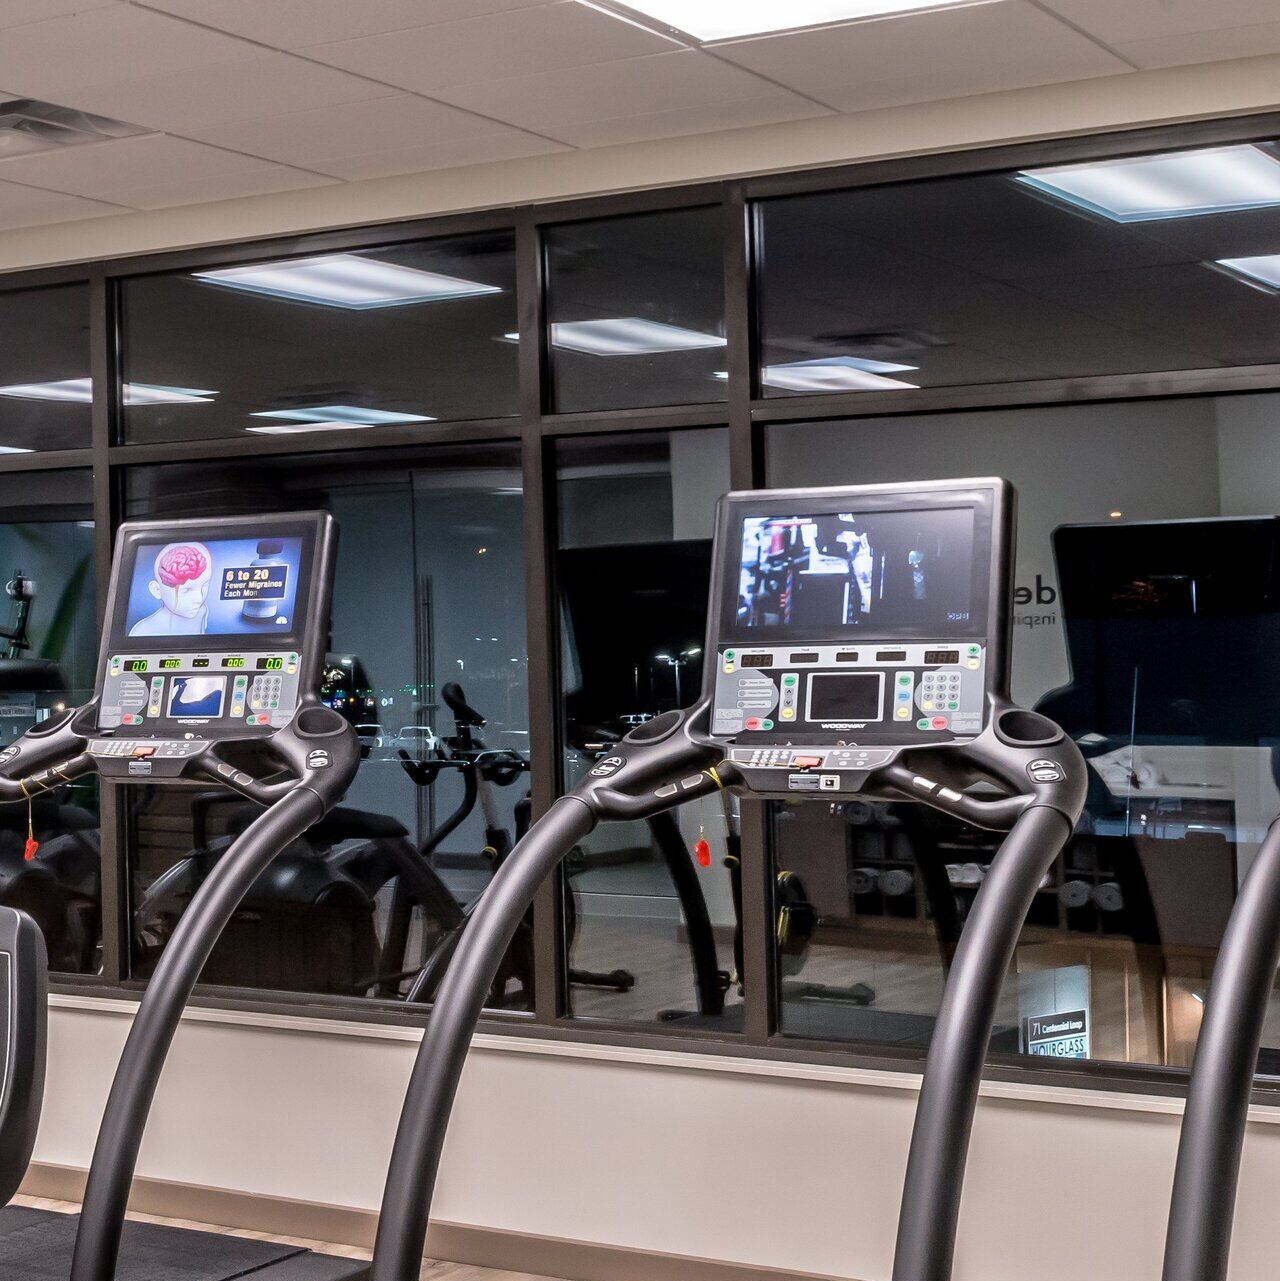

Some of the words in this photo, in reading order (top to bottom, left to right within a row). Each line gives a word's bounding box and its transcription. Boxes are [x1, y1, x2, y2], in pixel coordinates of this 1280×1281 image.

[226, 571, 234, 581] 6
[238, 571, 250, 580] to
[254, 569, 269, 579] 20
[248, 581, 283, 589] Migraines
